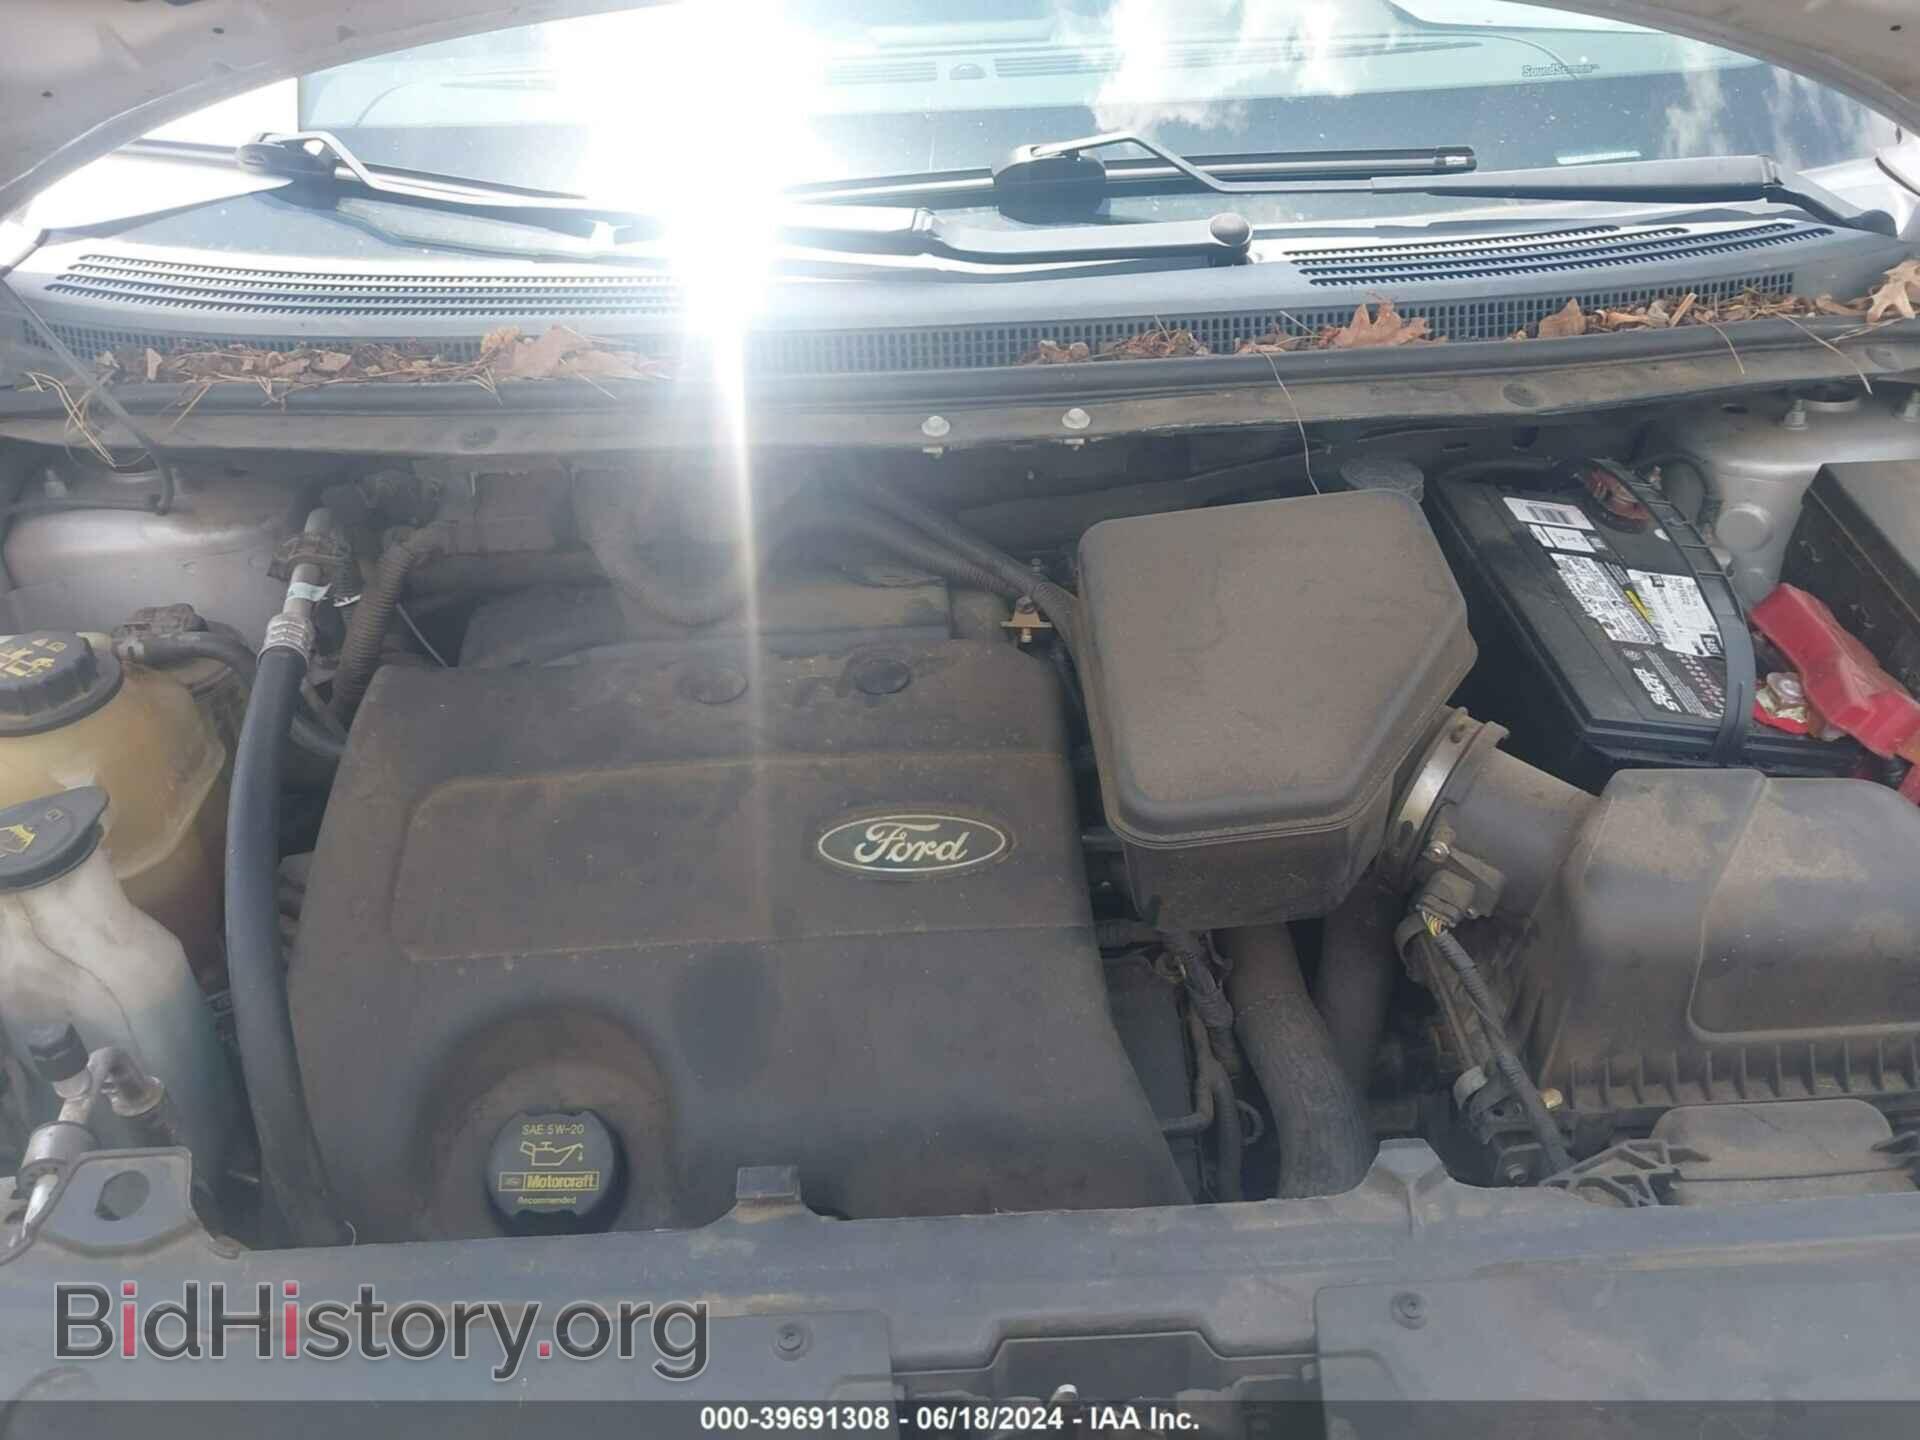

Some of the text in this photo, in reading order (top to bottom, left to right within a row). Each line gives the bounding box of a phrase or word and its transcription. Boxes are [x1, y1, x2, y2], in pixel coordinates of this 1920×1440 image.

[854, 822, 971, 864] Ford
[521, 1123, 585, 1136] SAE 5W-20
[527, 1174, 594, 1189] Motorcraft
